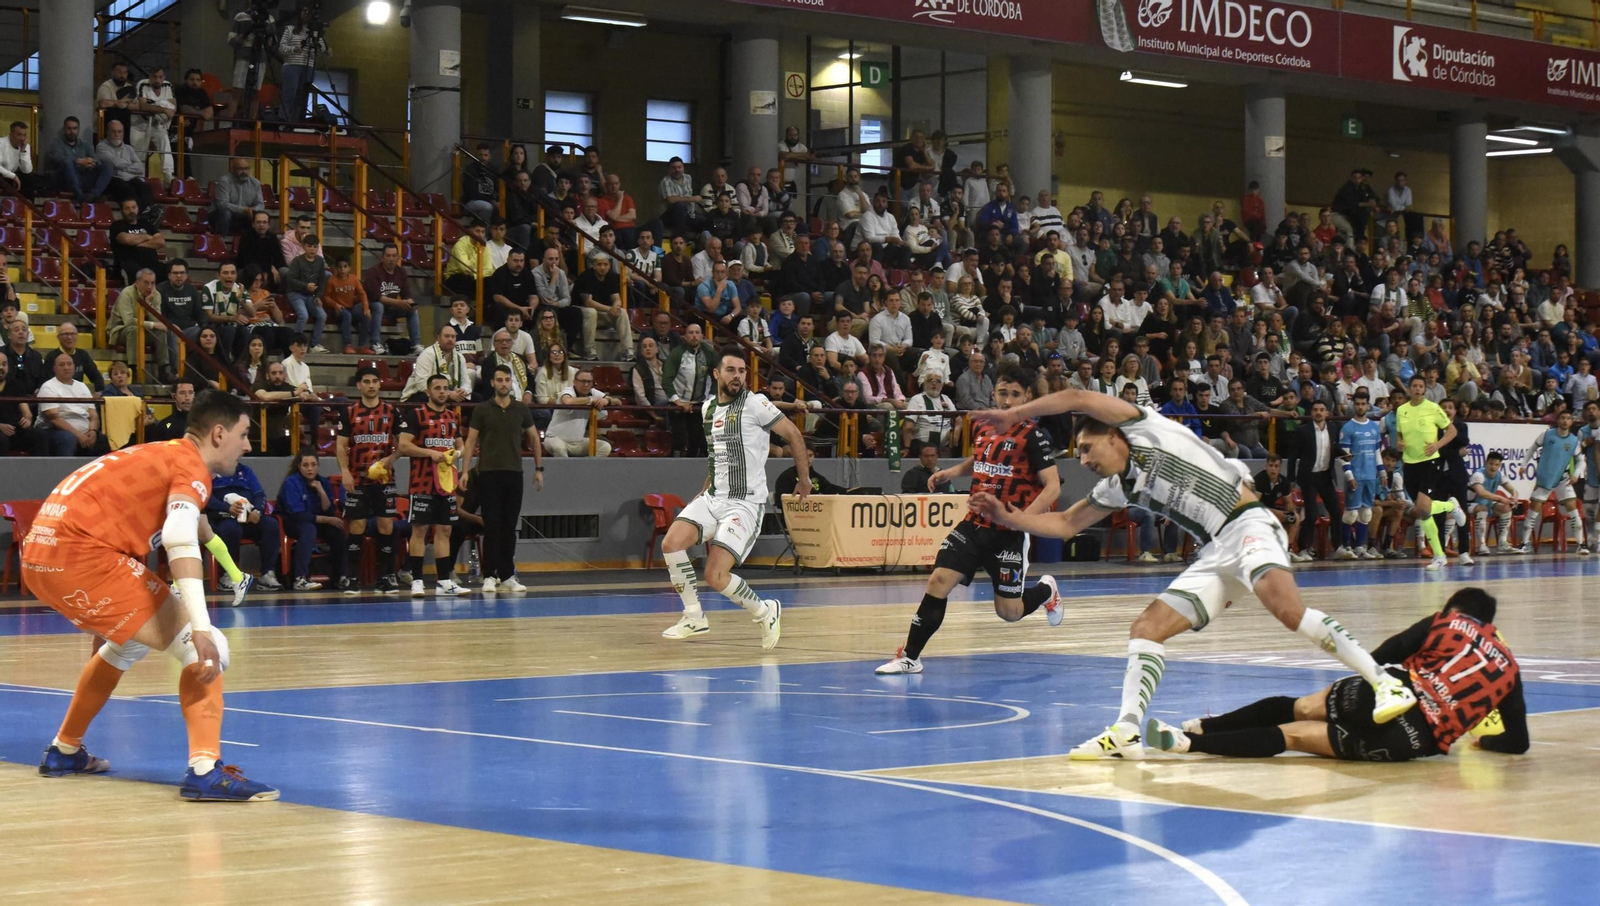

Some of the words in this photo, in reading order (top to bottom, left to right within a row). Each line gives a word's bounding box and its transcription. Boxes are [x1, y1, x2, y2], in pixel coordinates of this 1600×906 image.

[957, 0, 970, 13] DE
[1180, 0, 1313, 48] IMDECO
[1138, 36, 1174, 51] Instituto
[1177, 41, 1219, 58] Municipal
[1221, 49, 1233, 60] de
[1235, 49, 1274, 64] Deportes
[1275, 54, 1311, 69] Córdoba
[1433, 44, 1495, 68] Diputación
[870, 66, 881, 84] D
[1433, 64, 1447, 80] de
[1450, 66, 1496, 87] Córdoba
[1349, 118, 1357, 134] E
[983, 443, 992, 458] 4
[1449, 619, 1478, 643] RAÚL
[1479, 636, 1510, 672] LÓPEZ
[1440, 643, 1488, 683] 17
